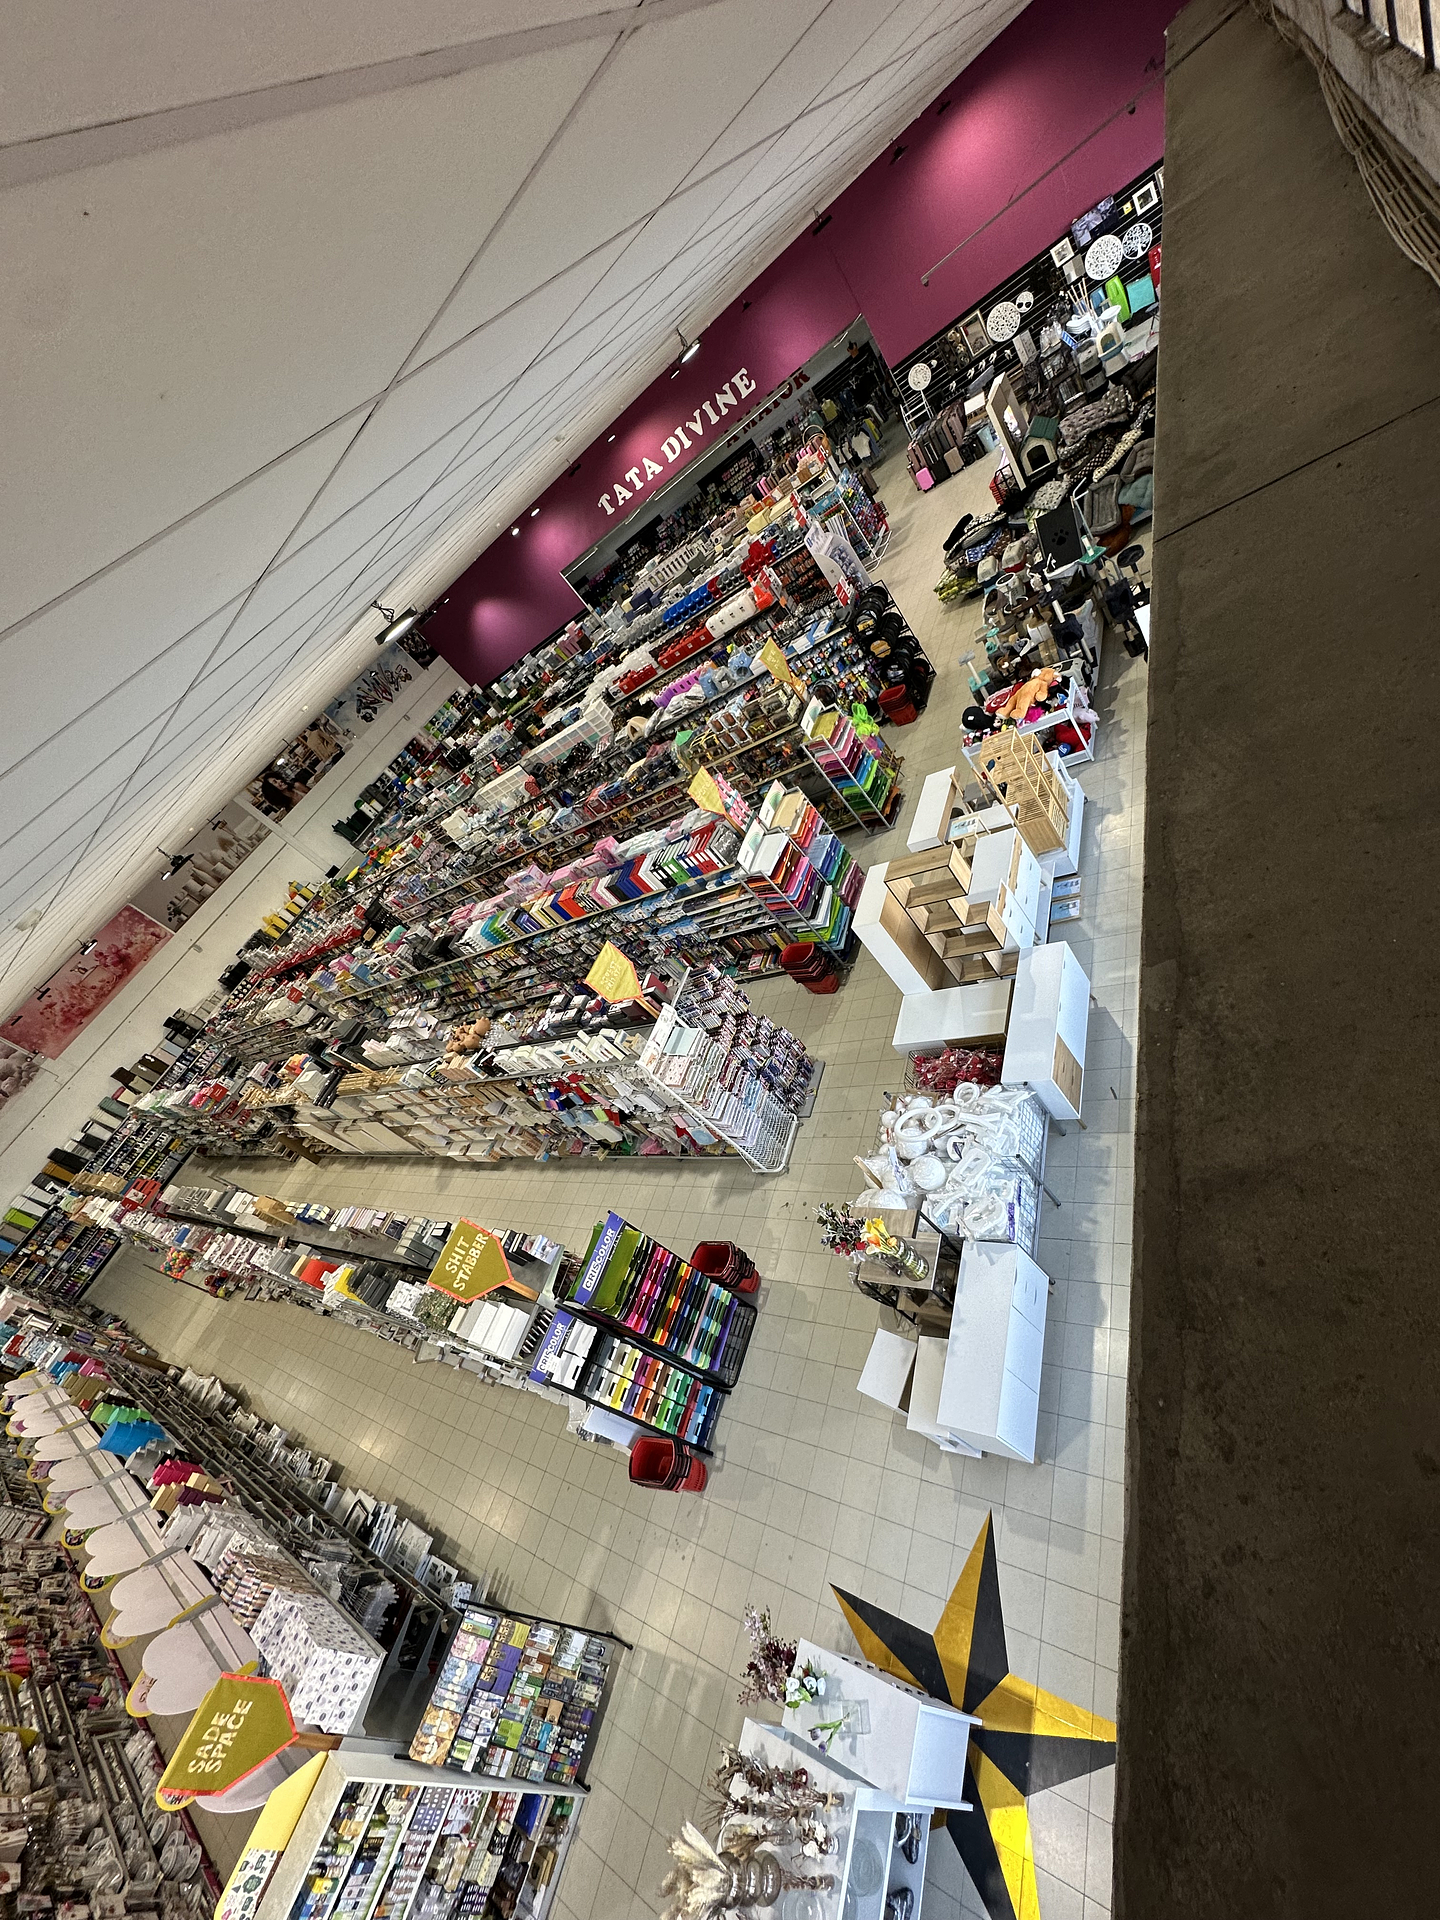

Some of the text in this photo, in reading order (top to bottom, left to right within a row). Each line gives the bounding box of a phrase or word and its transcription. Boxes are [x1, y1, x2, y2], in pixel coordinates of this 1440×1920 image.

[598, 367, 757, 515] TATA DIVINE
[445, 1235, 470, 1274] SHIT
[453, 1232, 490, 1292] STABBER
[585, 1228, 616, 1289] CRISCOLOR
[540, 1322, 565, 1371] CRISCOLOR
[187, 1711, 231, 1774] SADE
[204, 1699, 254, 1774] SPACE
